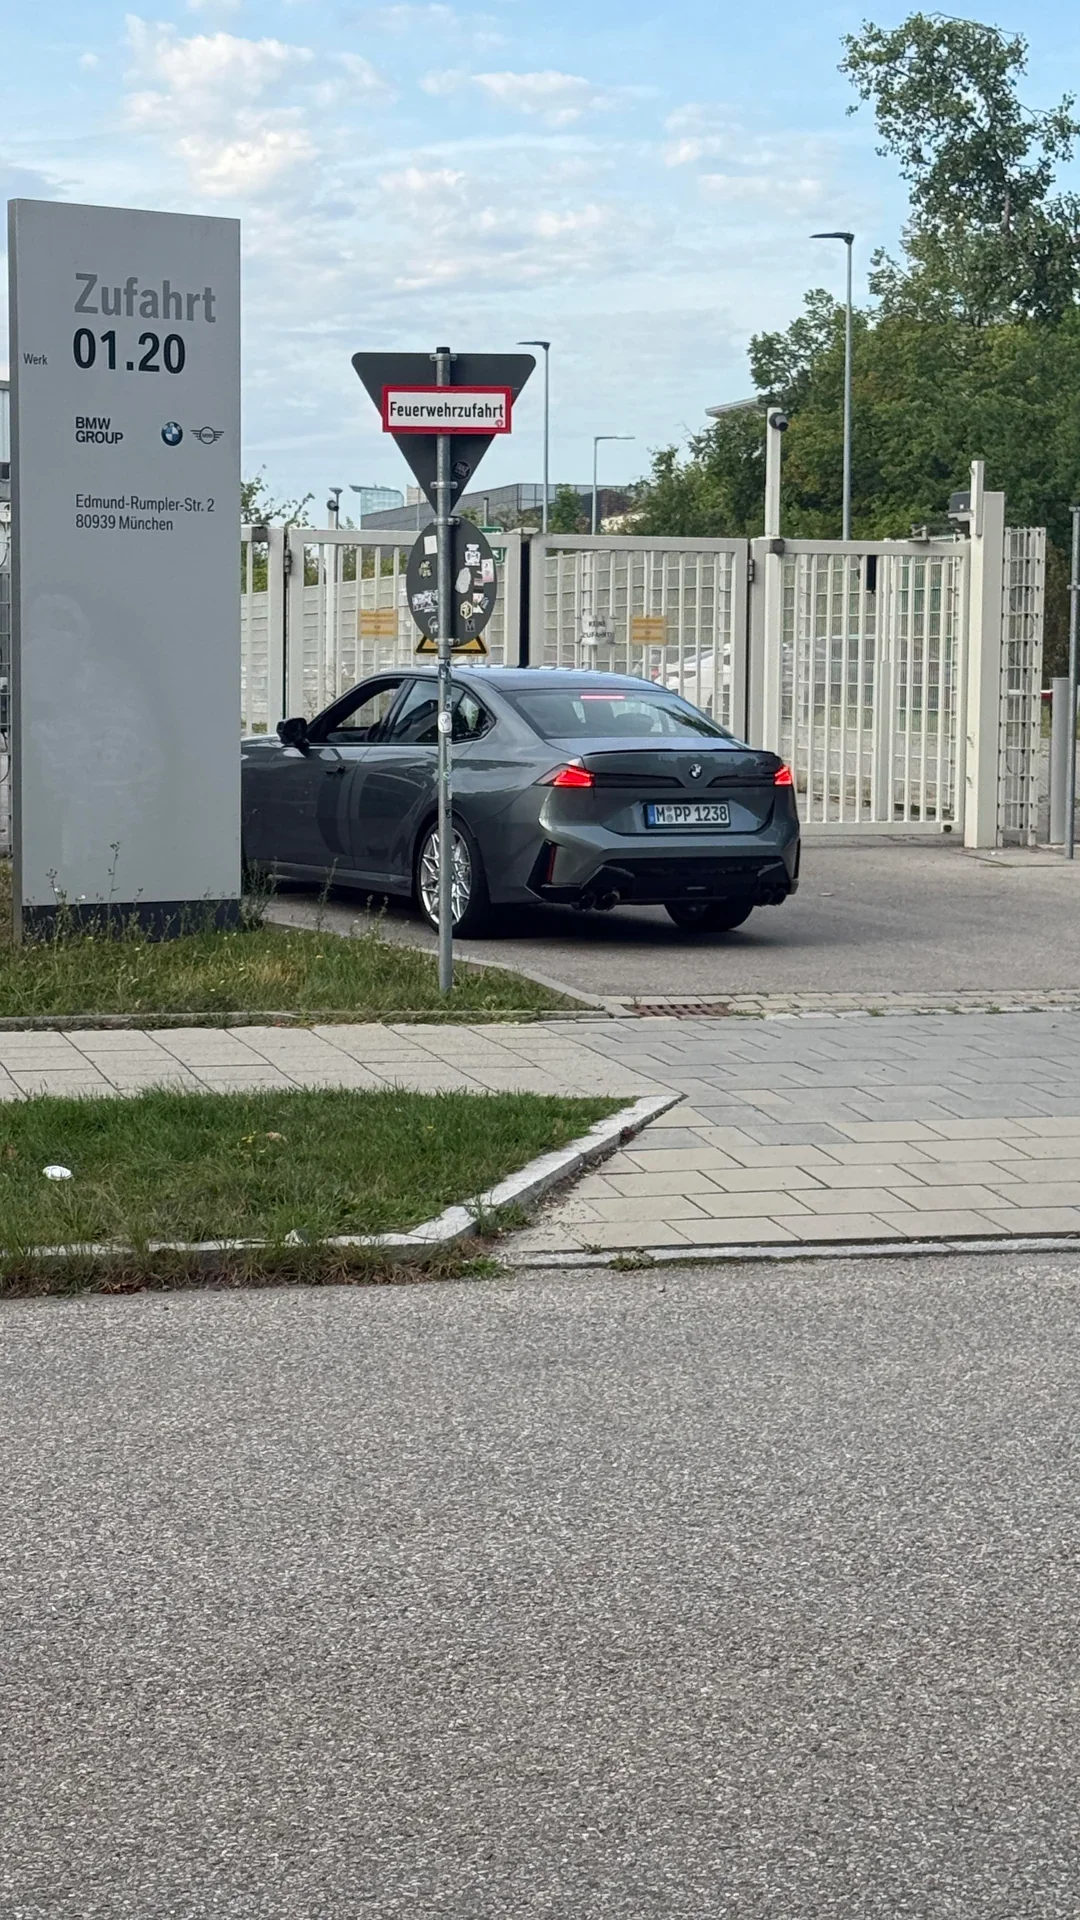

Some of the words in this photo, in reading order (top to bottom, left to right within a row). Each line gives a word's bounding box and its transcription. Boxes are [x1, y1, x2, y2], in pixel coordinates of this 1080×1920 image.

[74, 272, 216, 323] Zufahrt
[23, 353, 48, 365] Werk
[73, 328, 186, 374] 01.20
[389, 401, 504, 418] Feuerwehrzufahrt
[75, 417, 111, 429] BMW
[75, 431, 124, 444] GROUP
[75, 494, 205, 513] Edmund-Rumpler-Str.
[207, 499, 215, 512] 2
[75, 515, 116, 529] 80939
[119, 516, 174, 531] München
[655, 806, 666, 822] M
[673, 806, 691, 821] PP
[694, 806, 728, 821] 1238
